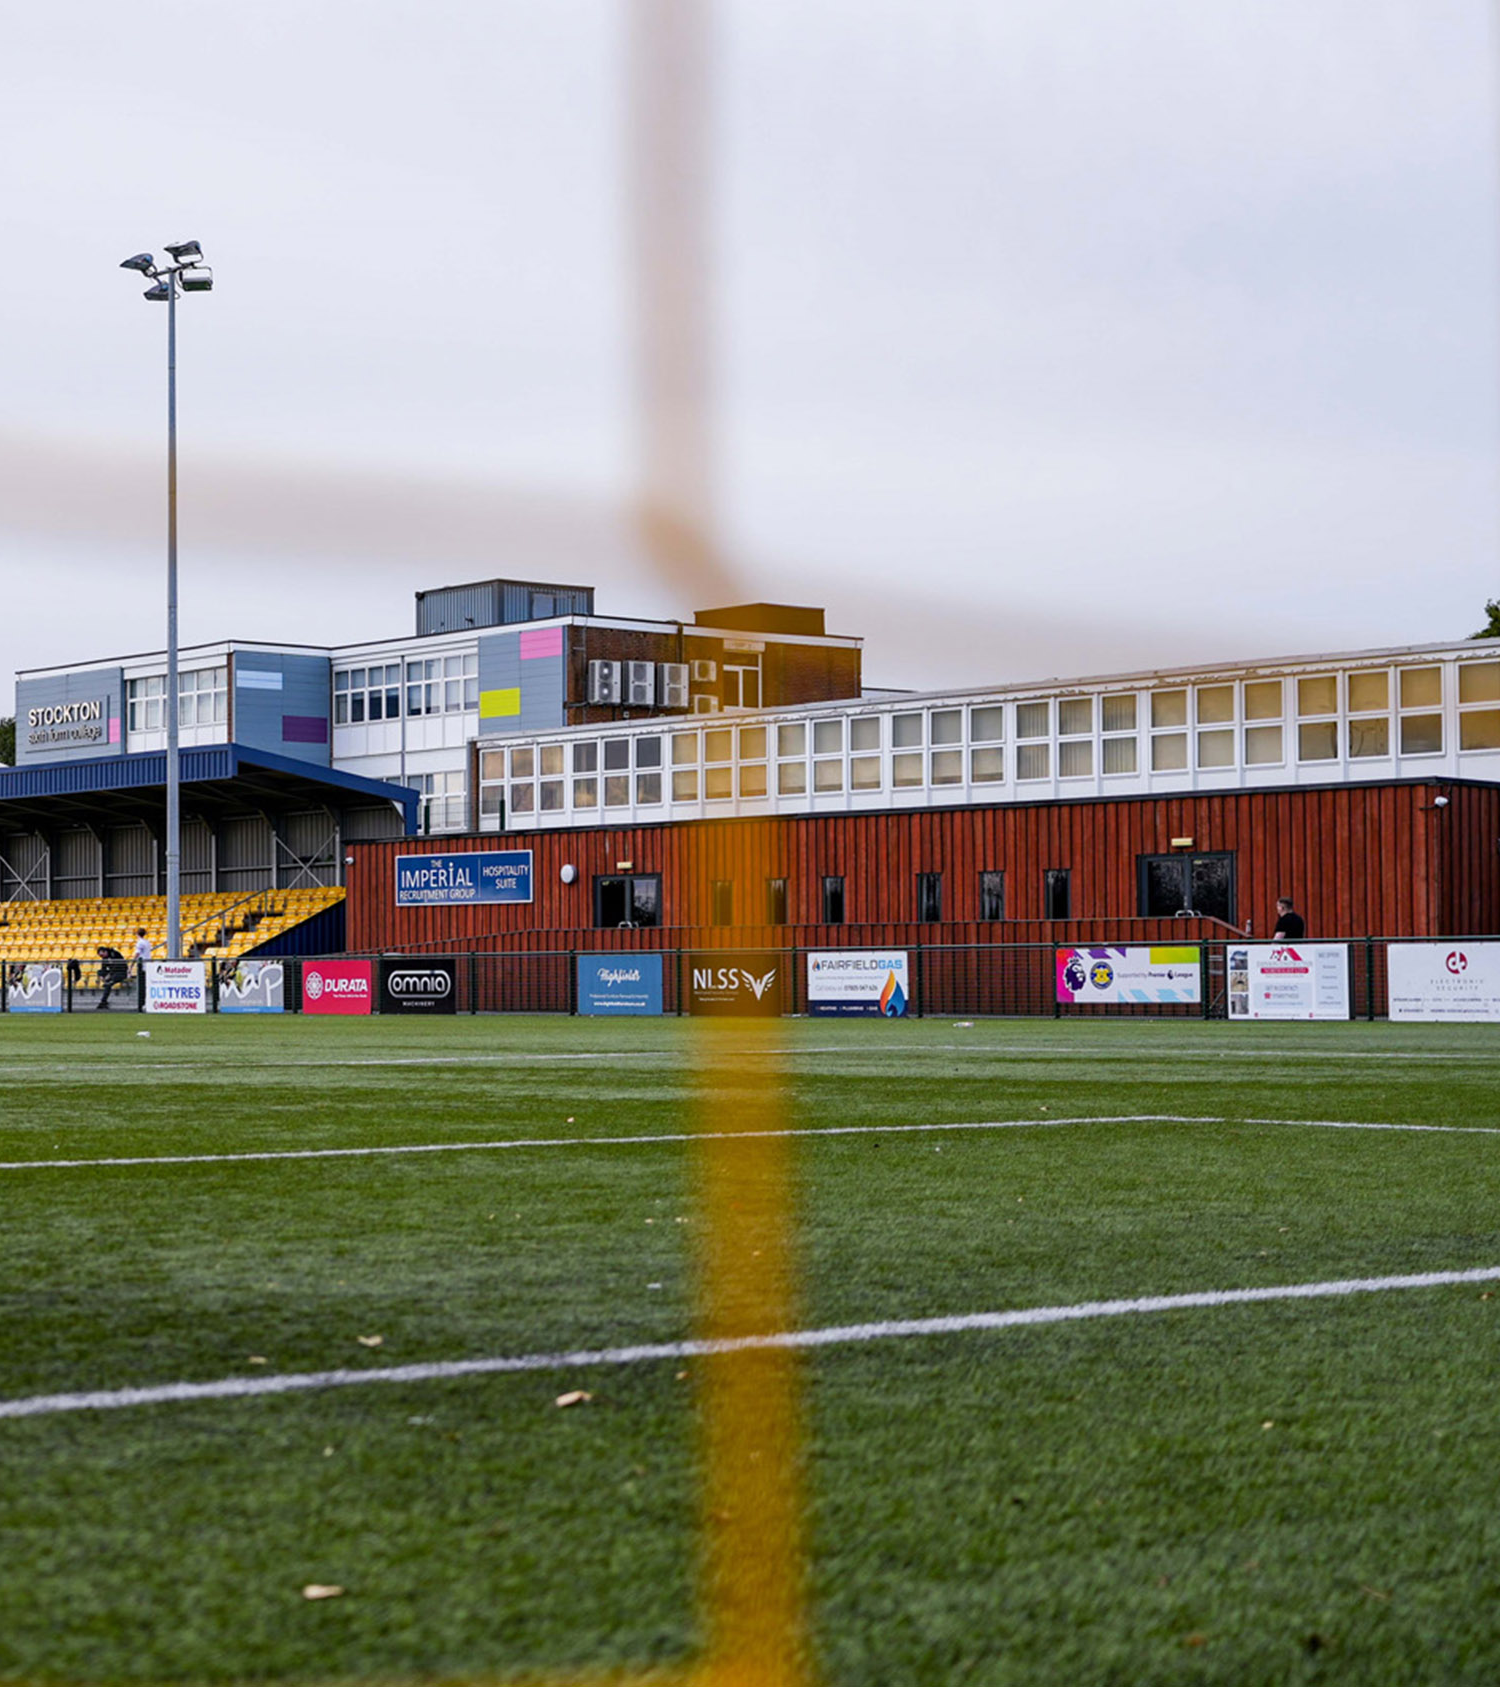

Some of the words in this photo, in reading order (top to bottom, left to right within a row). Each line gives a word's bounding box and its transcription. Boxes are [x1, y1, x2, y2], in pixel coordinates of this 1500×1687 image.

[28, 700, 101, 727] STOCKTON
[71, 724, 102, 742] college
[430, 859, 443, 868] THE
[482, 864, 529, 877] HOSPITALITY
[401, 862, 474, 889] IMPERIAL
[495, 878, 517, 889] SUITE
[399, 888, 449, 902] RECRUITMENT
[449, 888, 477, 899] GROUP
[164, 966, 192, 974] Matador
[1117, 971, 1141, 979] Supported
[1174, 971, 1193, 979] League
[324, 978, 369, 993] DURATA
[392, 976, 446, 993] omnia
[693, 968, 740, 990] NLSS
